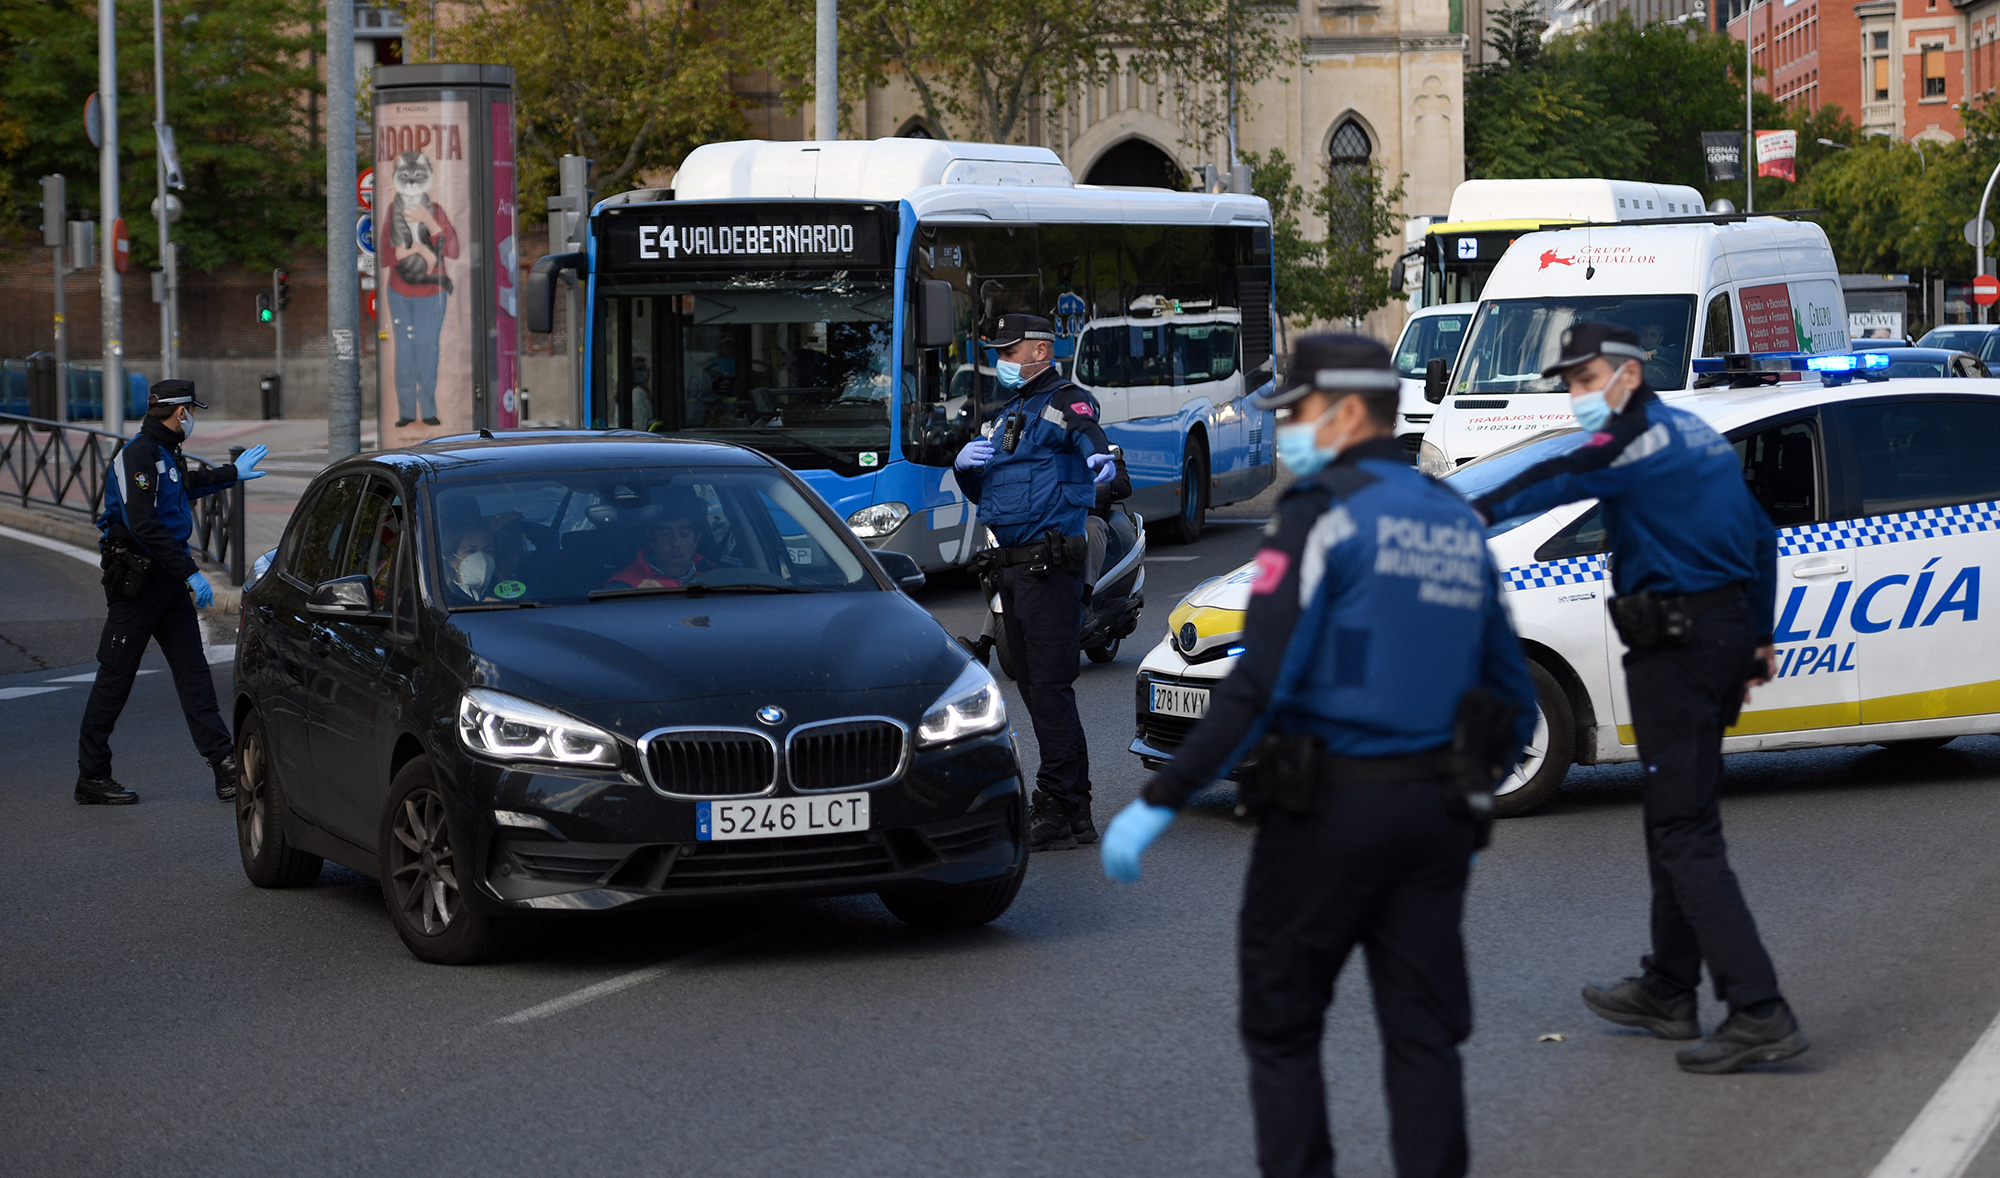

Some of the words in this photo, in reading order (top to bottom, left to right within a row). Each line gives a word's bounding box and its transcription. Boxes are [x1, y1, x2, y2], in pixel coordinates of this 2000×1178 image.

[377, 124, 462, 162] ADOPTA
[639, 225, 679, 260] E4
[682, 224, 854, 255] VALDEBERNARDO
[1577, 256, 1656, 264] GELIALLOR
[1440, 321, 1460, 330] LIBRE
[1854, 313, 1897, 326] LOEWE
[1468, 414, 1535, 424] TRABAJOS
[1773, 556, 1981, 644] LICÍA
[1155, 688, 1179, 712] 2781
[1183, 690, 1206, 714] KVY
[701, 824, 707, 833] E
[719, 803, 796, 834] 5246
[808, 798, 862, 829] LCT
